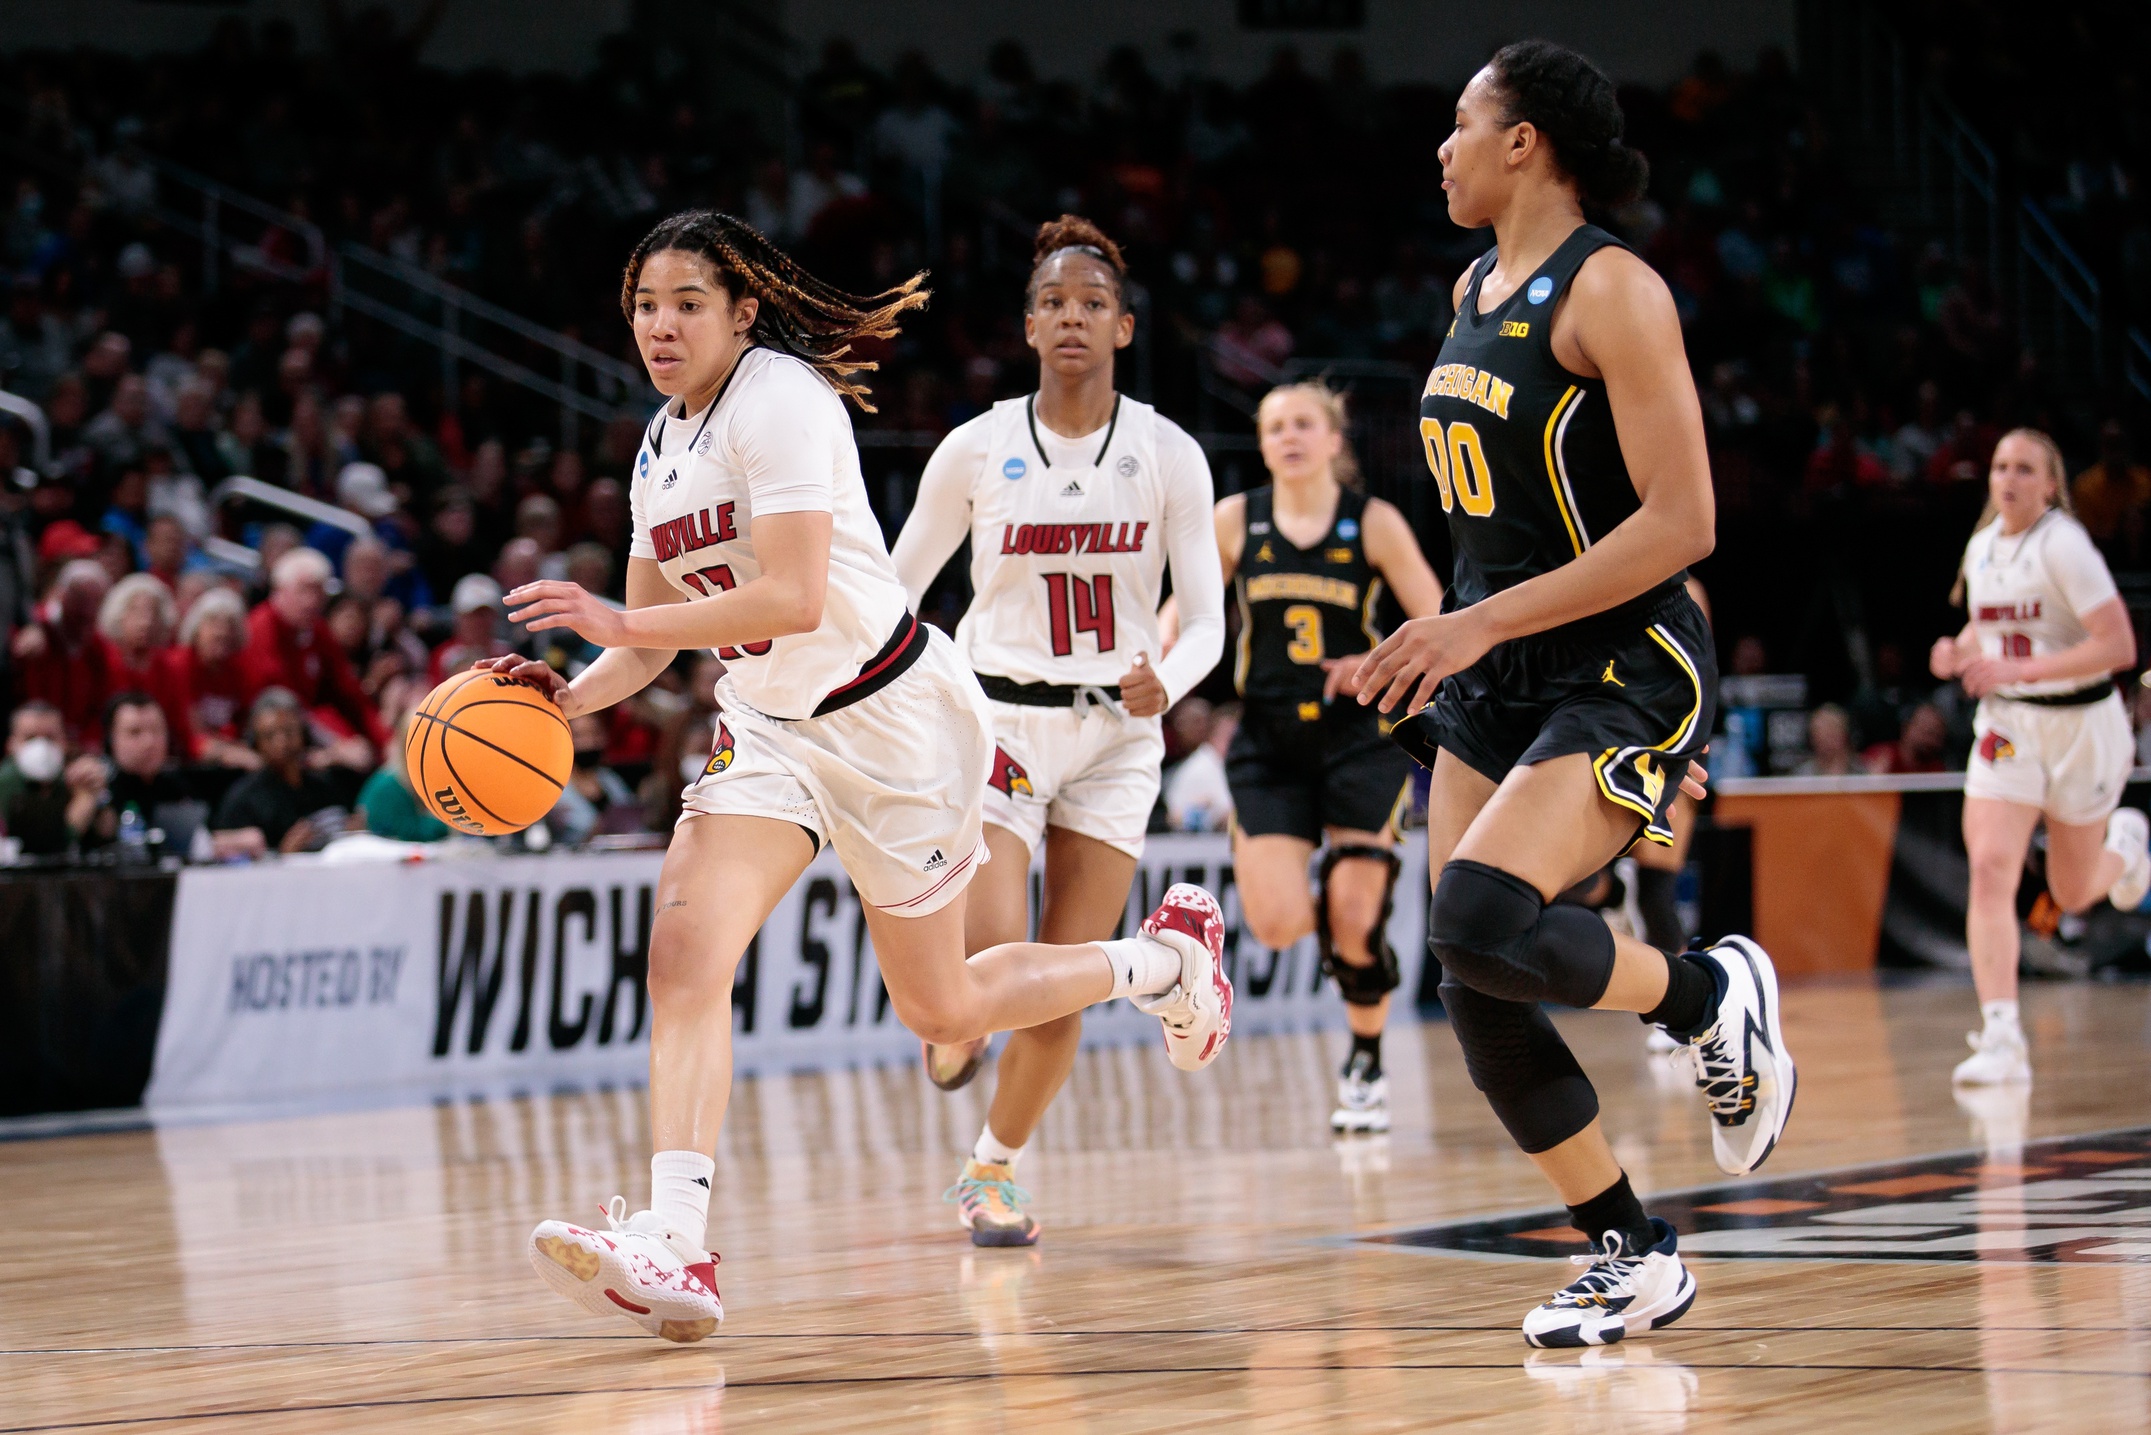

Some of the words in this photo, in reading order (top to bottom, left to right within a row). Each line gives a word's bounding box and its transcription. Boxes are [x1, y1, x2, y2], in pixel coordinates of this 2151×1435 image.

[1419, 417, 1495, 518] 00
[650, 500, 738, 564] UISVILLE
[1000, 521, 1149, 557] LOUISVILLE
[1040, 572, 1115, 658] 14
[1284, 604, 1323, 665] 3
[923, 860, 948, 872] adidas
[231, 950, 359, 1012] HOSTED
[367, 945, 404, 1004] BY
[430, 885, 759, 1058] WICHA
